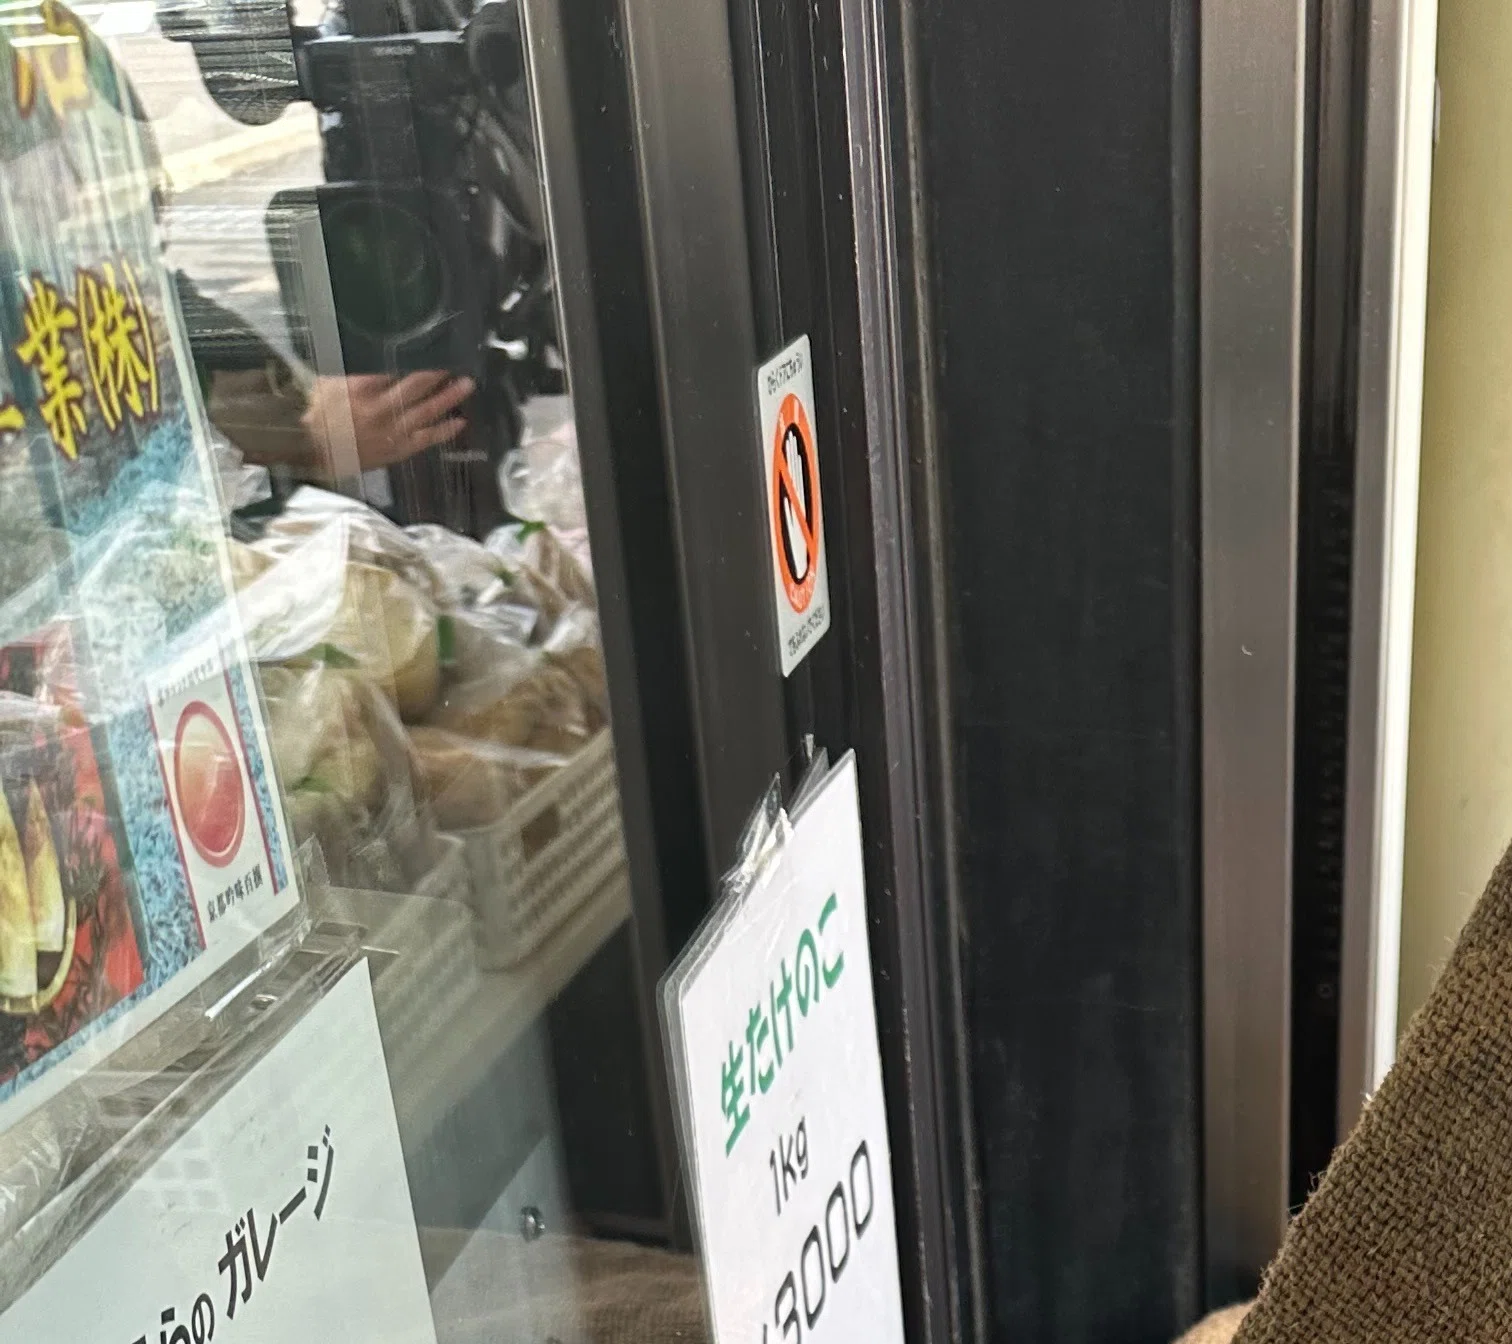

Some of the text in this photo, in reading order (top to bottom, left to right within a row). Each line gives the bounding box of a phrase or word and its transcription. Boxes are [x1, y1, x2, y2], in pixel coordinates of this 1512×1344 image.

[721, 891, 845, 1159] 生たけのこ
[769, 1115, 809, 1217] 1kg
